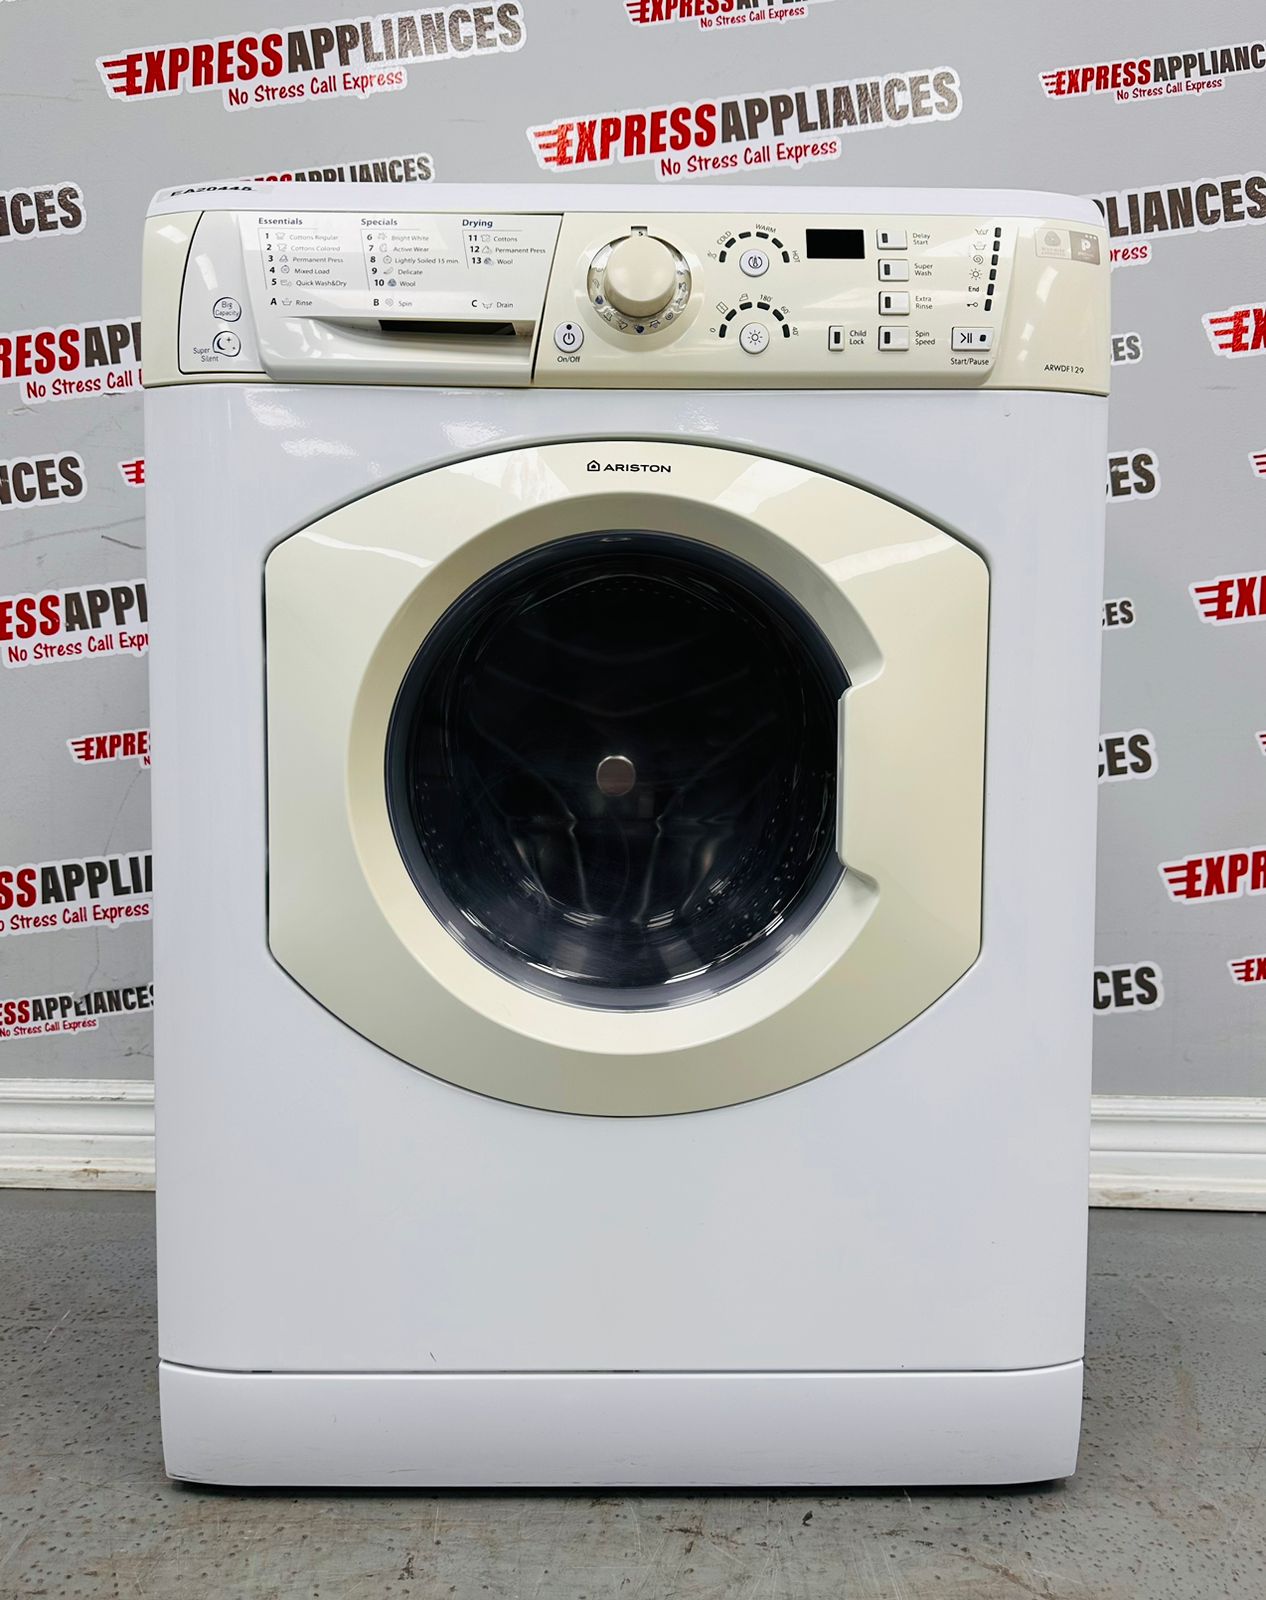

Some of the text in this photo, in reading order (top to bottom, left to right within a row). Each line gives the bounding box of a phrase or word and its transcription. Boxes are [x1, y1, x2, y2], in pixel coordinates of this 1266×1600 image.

[700, 7, 805, 28] No Stress Call Express
[228, 69, 404, 106] No Stress Call Express
[1116, 78, 1222, 101] No Stress Call Express
[660, 139, 838, 177] No Stress Call Express
[258, 217, 303, 225] Essentials
[360, 218, 398, 226] Specials
[462, 218, 493, 228] Drying
[755, 223, 777, 234] WARM
[315, 234, 339, 242] Regular
[468, 234, 478, 242] 11
[716, 230, 732, 245] COLD
[470, 245, 480, 253] 12
[395, 257, 417, 265] Lightly
[792, 250, 801, 263] HOT
[315, 280, 347, 288] Wash&Dry
[221, 301, 233, 310] Big
[270, 298, 277, 306] A
[471, 300, 478, 308] C
[215, 309, 239, 317] Capacity
[915, 330, 930, 338] Spin
[915, 338, 936, 346] Speed
[193, 347, 211, 355] Super
[201, 355, 219, 363] Silent
[950, 357, 990, 366] Start/Pause
[1043, 364, 1085, 374] ARWDF129
[27, 381, 46, 399] No
[52, 376, 101, 396] Stress
[106, 370, 133, 389] Call
[603, 463, 672, 473] ARISTON
[8, 646, 28, 663] No
[33, 641, 82, 660] Stress
[88, 633, 114, 652] Call
[10, 914, 57, 930] Stress
[62, 906, 88, 924] Call
[92, 903, 150, 923] Express
[0, 1019, 97, 1037] No Stress Call Express
